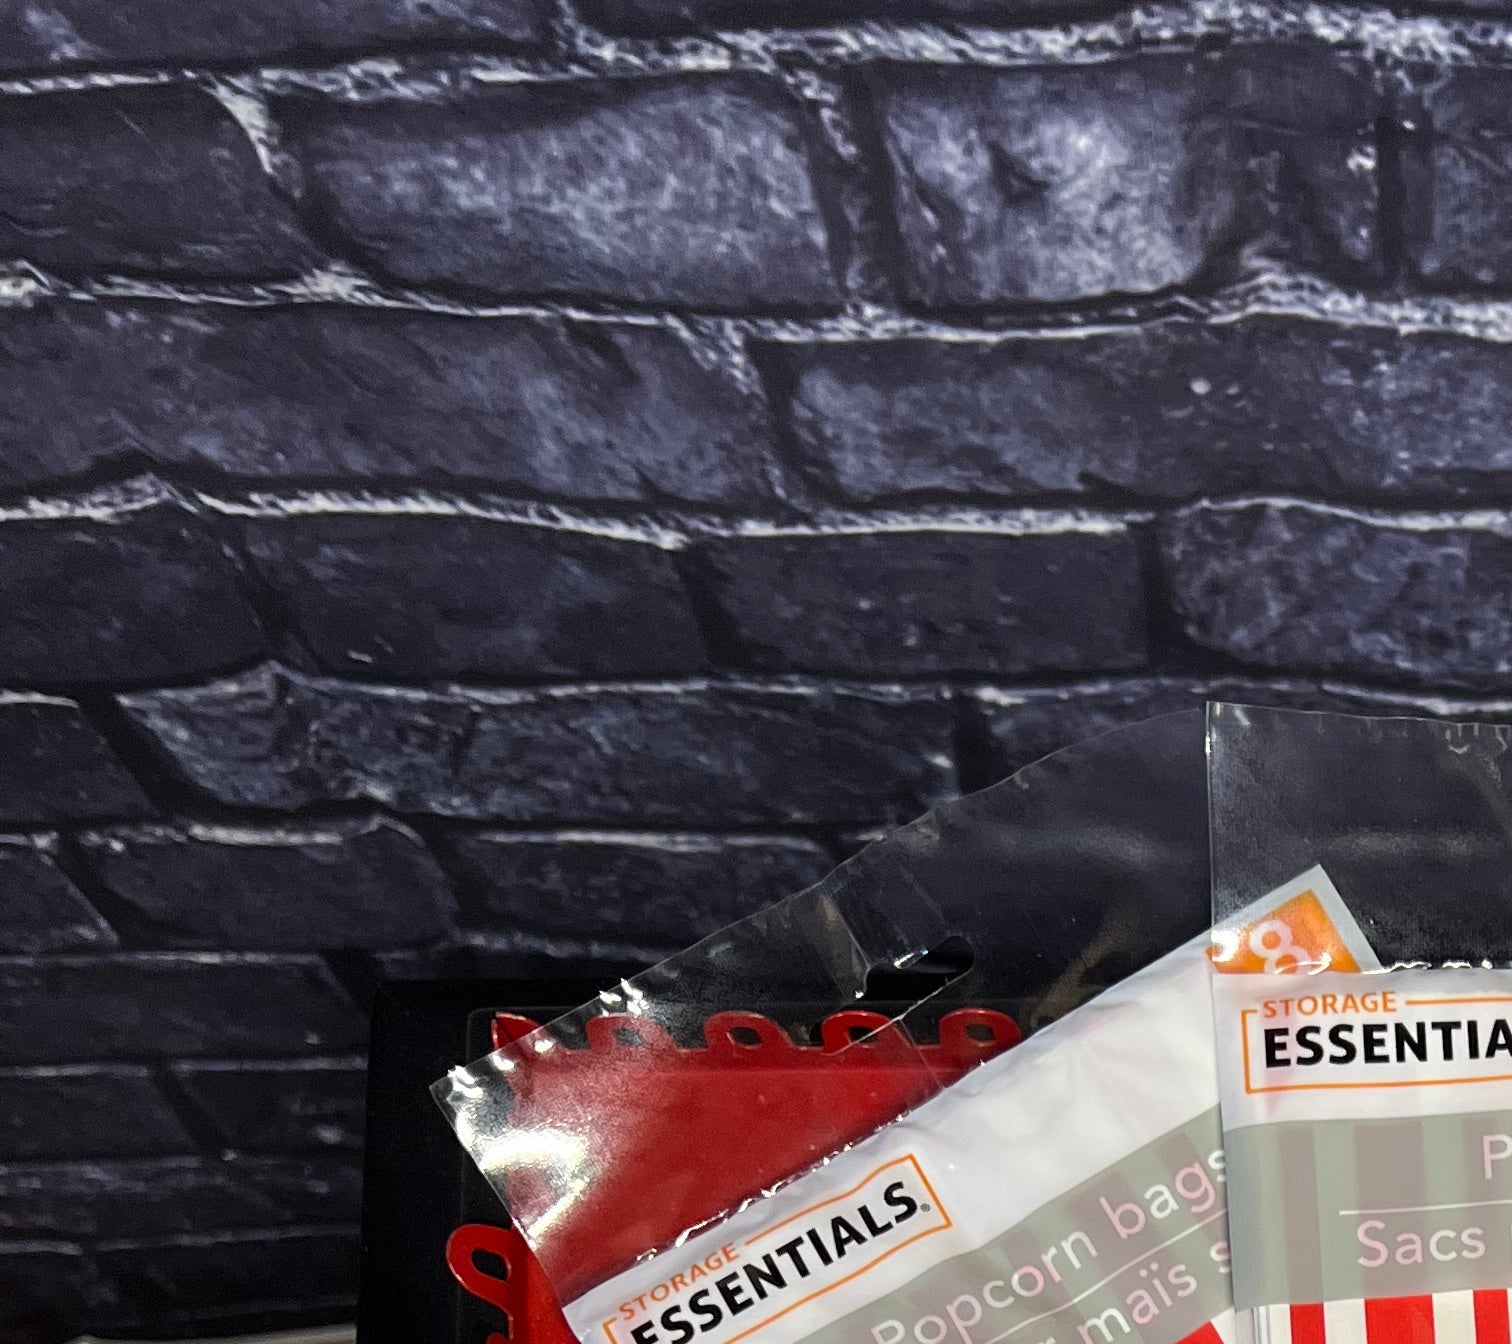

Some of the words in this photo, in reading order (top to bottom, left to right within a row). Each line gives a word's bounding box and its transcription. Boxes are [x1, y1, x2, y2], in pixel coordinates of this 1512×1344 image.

[1262, 991, 1397, 1019] STORAGE
[1357, 1221, 1485, 1268] Sacs
[617, 1242, 740, 1322] STORAGE
